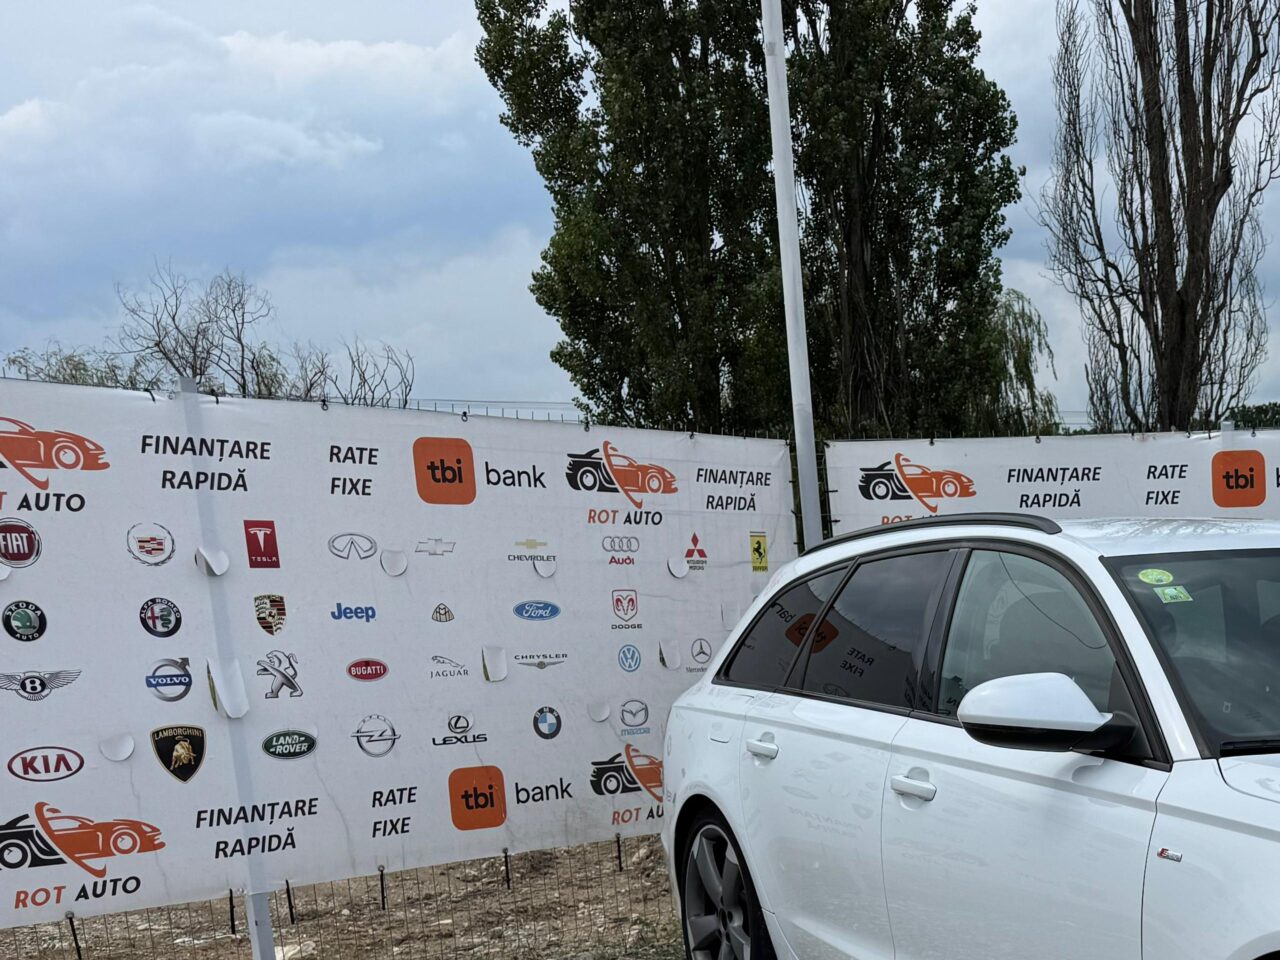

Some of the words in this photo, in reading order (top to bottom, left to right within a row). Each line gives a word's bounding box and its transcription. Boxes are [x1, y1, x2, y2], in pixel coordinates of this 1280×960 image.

[141, 435, 271, 463] FINANȚARE
[329, 445, 379, 465] RATE
[162, 469, 248, 492] RAPIDĂ
[427, 458, 463, 484] tbi
[484, 461, 547, 489] bank
[696, 467, 772, 488] FINANȚARE
[1007, 466, 1101, 486] FINANȚARE
[1146, 464, 1188, 480] RATE
[1222, 467, 1255, 490] tbi
[330, 477, 372, 496] FIXE
[17, 493, 86, 512] AUTO
[706, 493, 756, 512] RAPIDĂ
[1019, 489, 1082, 509] RAPIDĂ
[1145, 490, 1180, 505] FIXE
[587, 509, 618, 525] ROT
[623, 511, 664, 526] AUTO
[0, 533, 29, 554] FIAT
[609, 556, 635, 565] Audi
[331, 602, 376, 622] Jeep
[523, 603, 552, 617] Ford
[351, 664, 385, 676] BUGATTI
[430, 669, 469, 679] JAGUAR
[149, 676, 189, 685] VOLVO
[154, 727, 202, 740] LAMBORGHINI
[432, 733, 488, 746] LEXUS
[20, 753, 73, 776] KIA
[371, 786, 418, 808] RATE
[460, 784, 495, 810] tbi
[515, 777, 573, 805] bank
[195, 798, 319, 829] FINANȚARE
[611, 807, 642, 826] ROT
[646, 804, 664, 820] AU
[371, 817, 411, 838] FIXE
[214, 827, 297, 859] RAPIDĂ
[14, 885, 66, 909] ROT
[74, 876, 142, 902] AUTO
